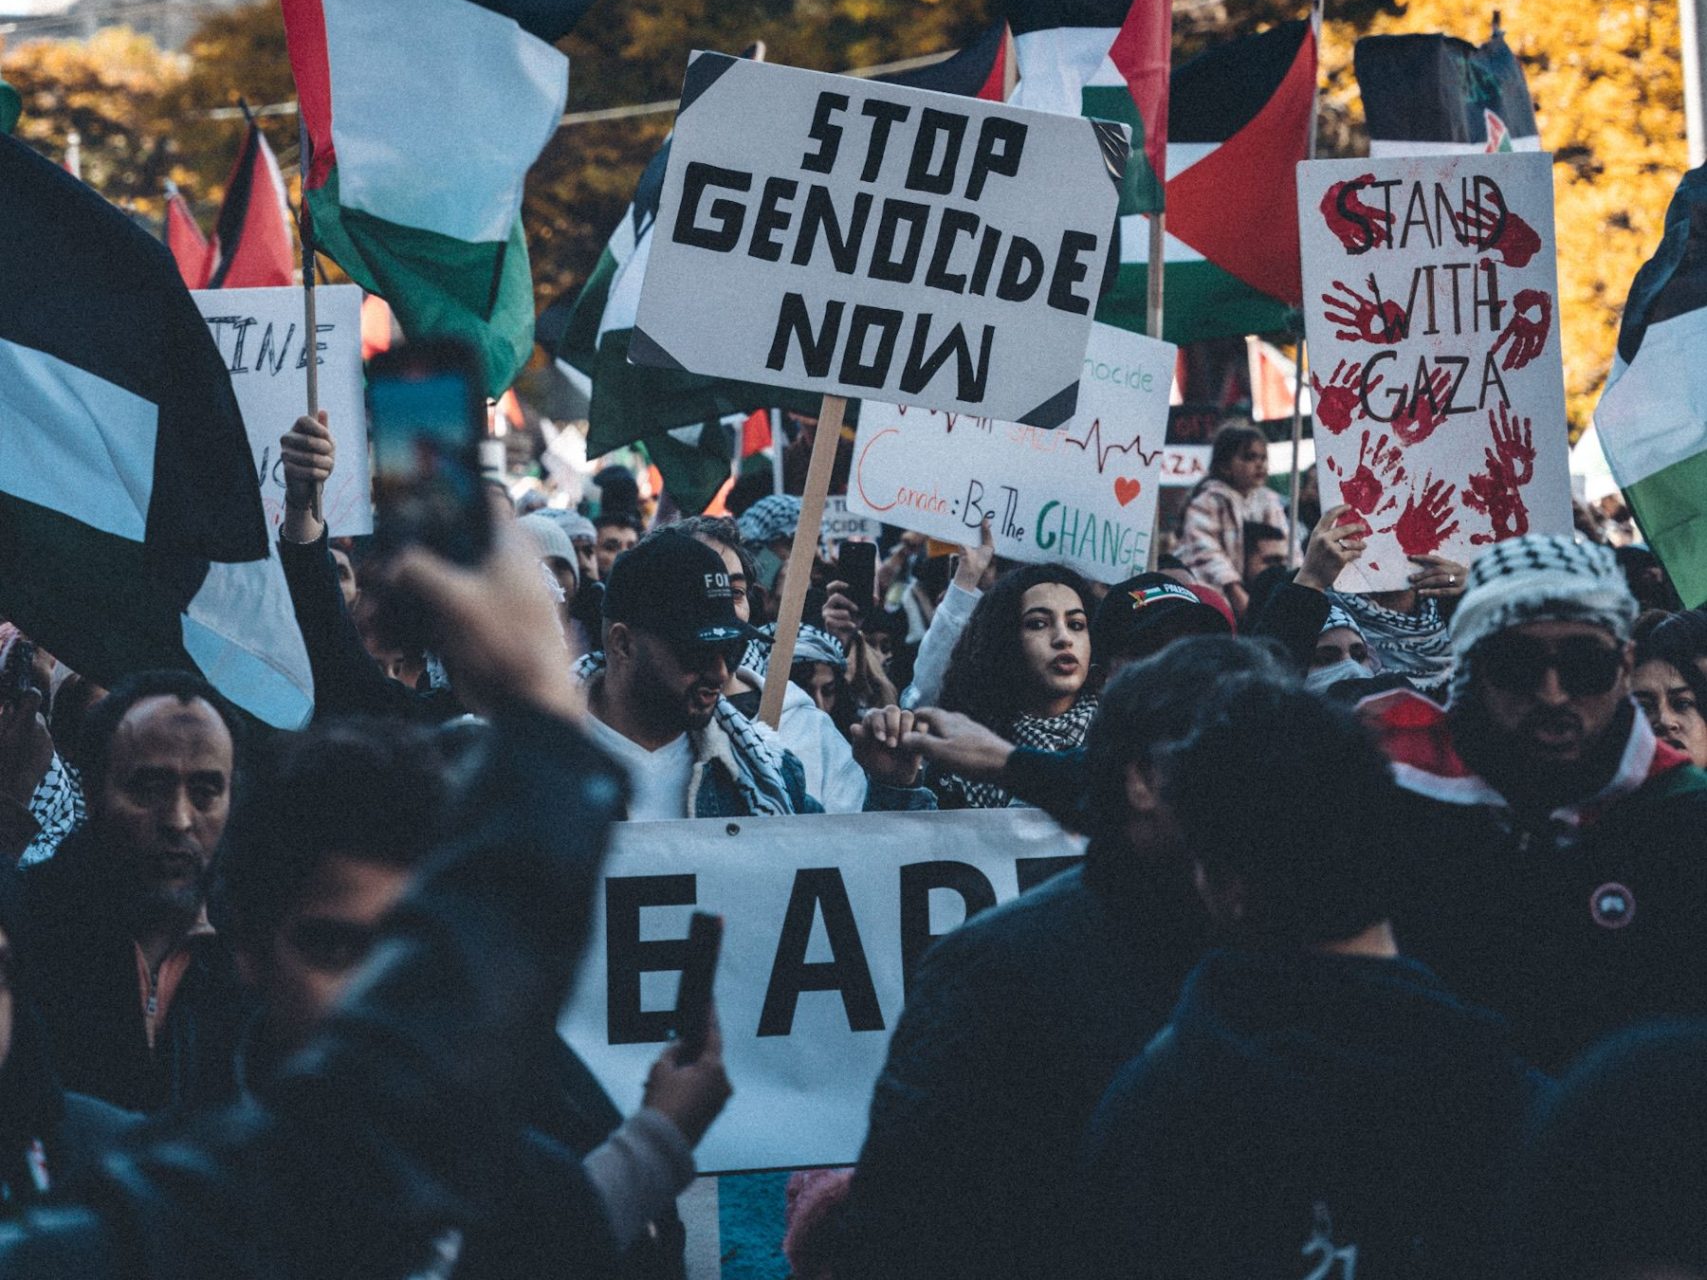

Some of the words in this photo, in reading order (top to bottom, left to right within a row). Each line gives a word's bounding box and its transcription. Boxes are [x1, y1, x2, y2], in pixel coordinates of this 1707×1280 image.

[800, 91, 1028, 201] STOP
[672, 162, 1097, 316] GENOCIDE
[1337, 175, 1508, 255] STAND
[1368, 263, 1500, 344] WITH
[766, 293, 995, 403] NOW
[1359, 350, 1511, 422] GAZA
[1160, 454, 1203, 474] ZA
[962, 479, 996, 528] Be
[1000, 485, 1025, 542] The
[1036, 500, 1149, 573] CHANGE
